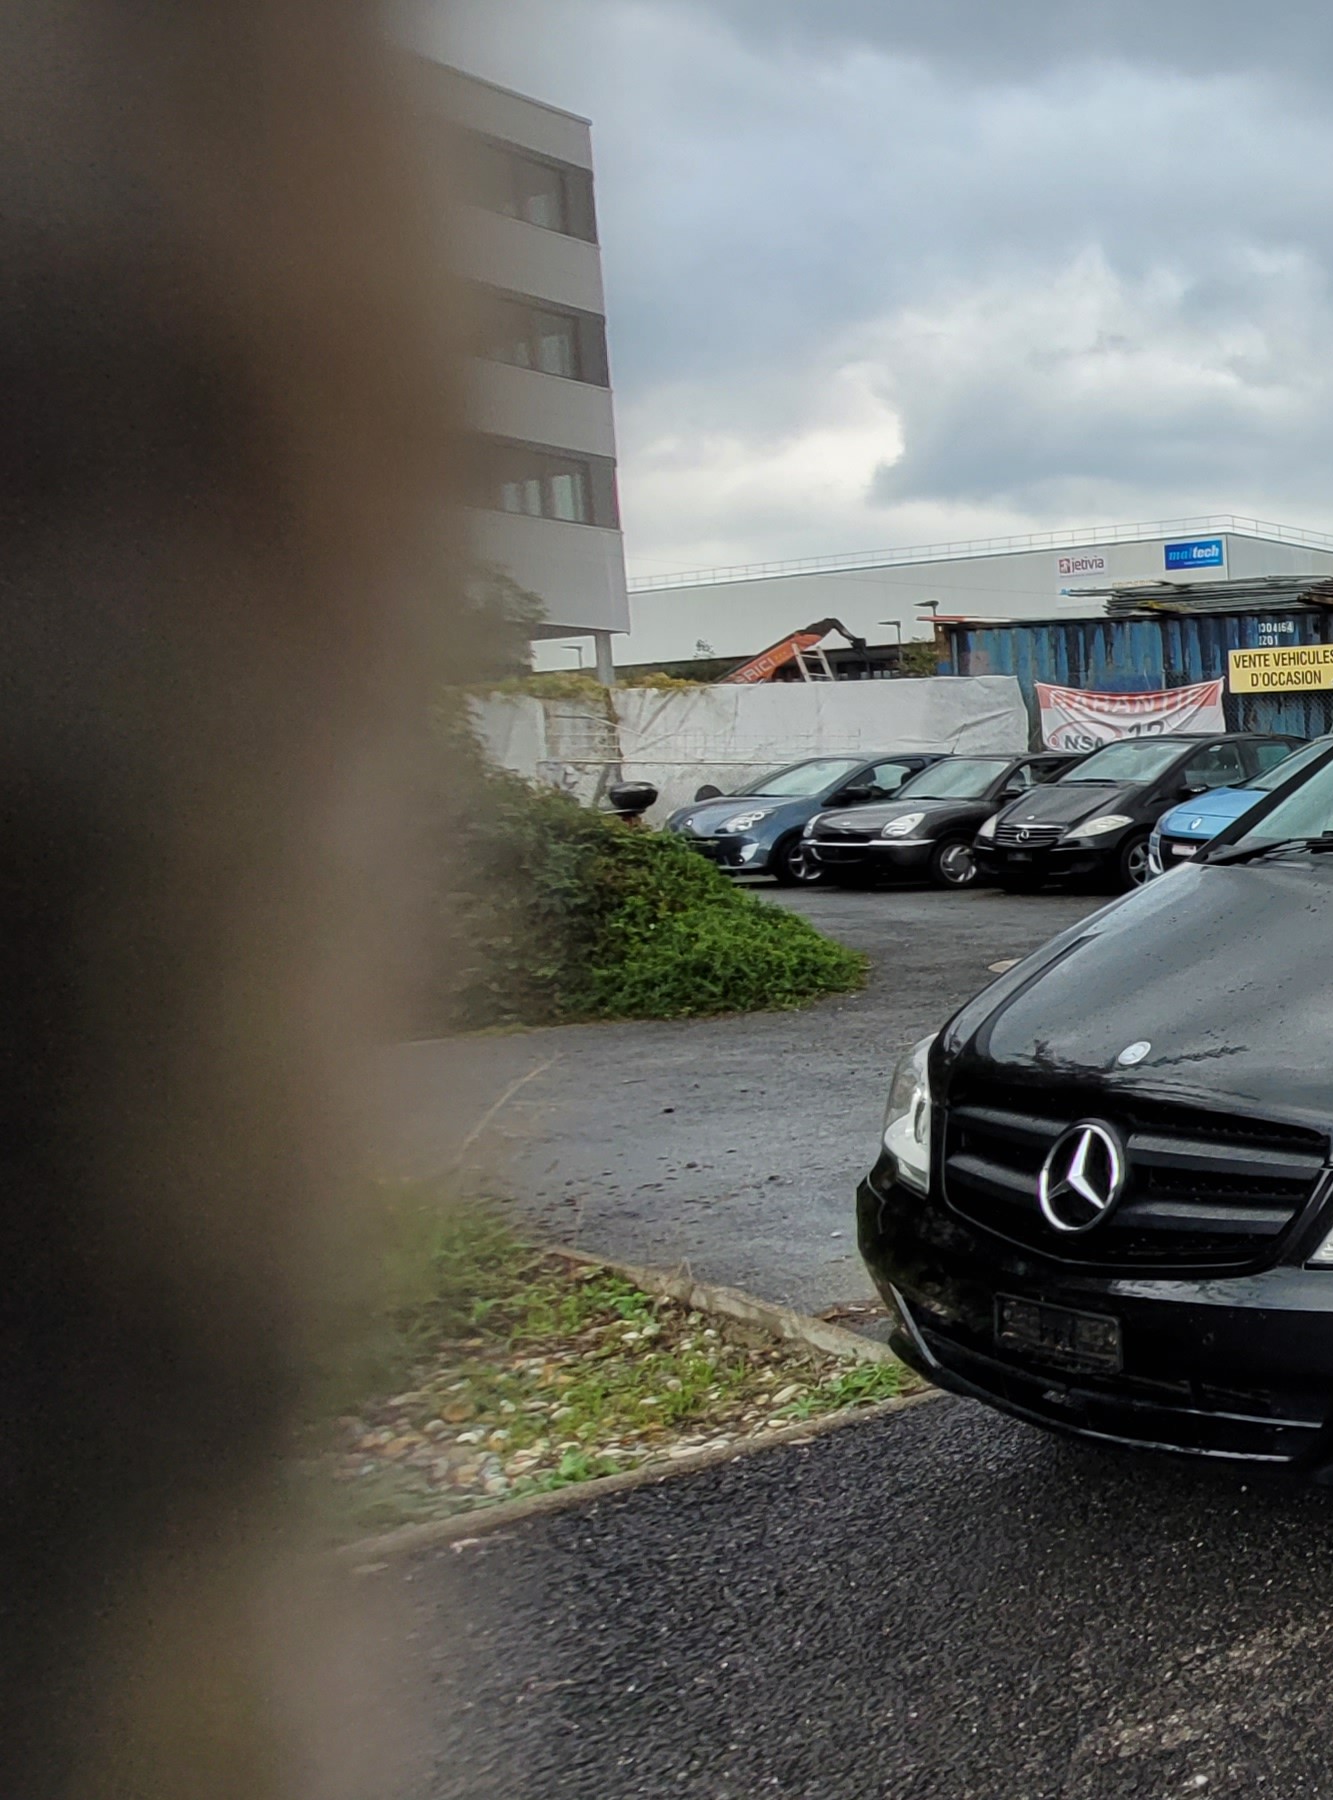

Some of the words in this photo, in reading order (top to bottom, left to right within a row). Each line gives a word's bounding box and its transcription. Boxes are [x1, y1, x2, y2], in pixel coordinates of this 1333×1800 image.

[1071, 555, 1105, 573] jetivia
[1233, 653, 1271, 669] VENTE
[1250, 670, 1322, 687] D'OCCASION
